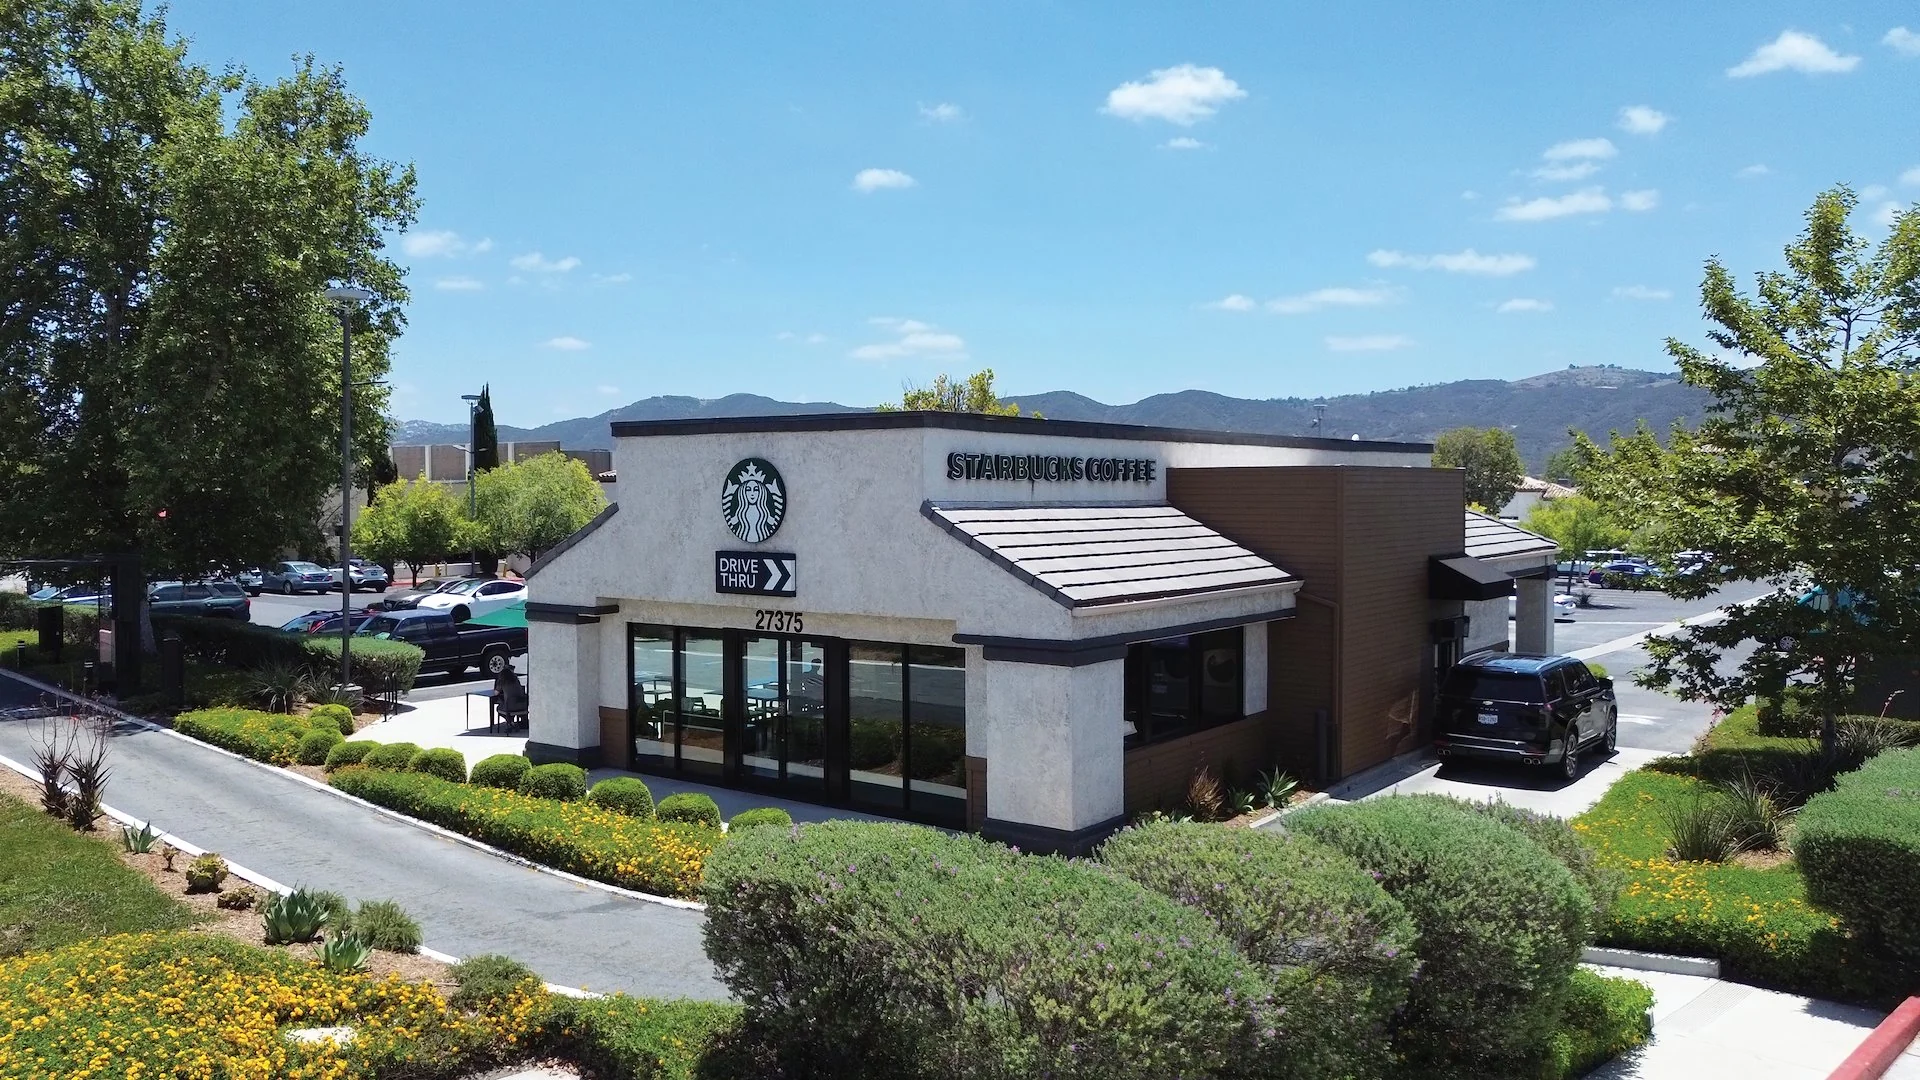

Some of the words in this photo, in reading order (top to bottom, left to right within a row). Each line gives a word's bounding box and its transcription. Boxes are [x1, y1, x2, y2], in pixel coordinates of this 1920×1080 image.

[947, 452, 1084, 481] STARBUCKS
[1085, 457, 1157, 482] COFFEE
[719, 557, 759, 574] DRIVE
[720, 573, 756, 588] THRU
[755, 609, 804, 633] 27375
